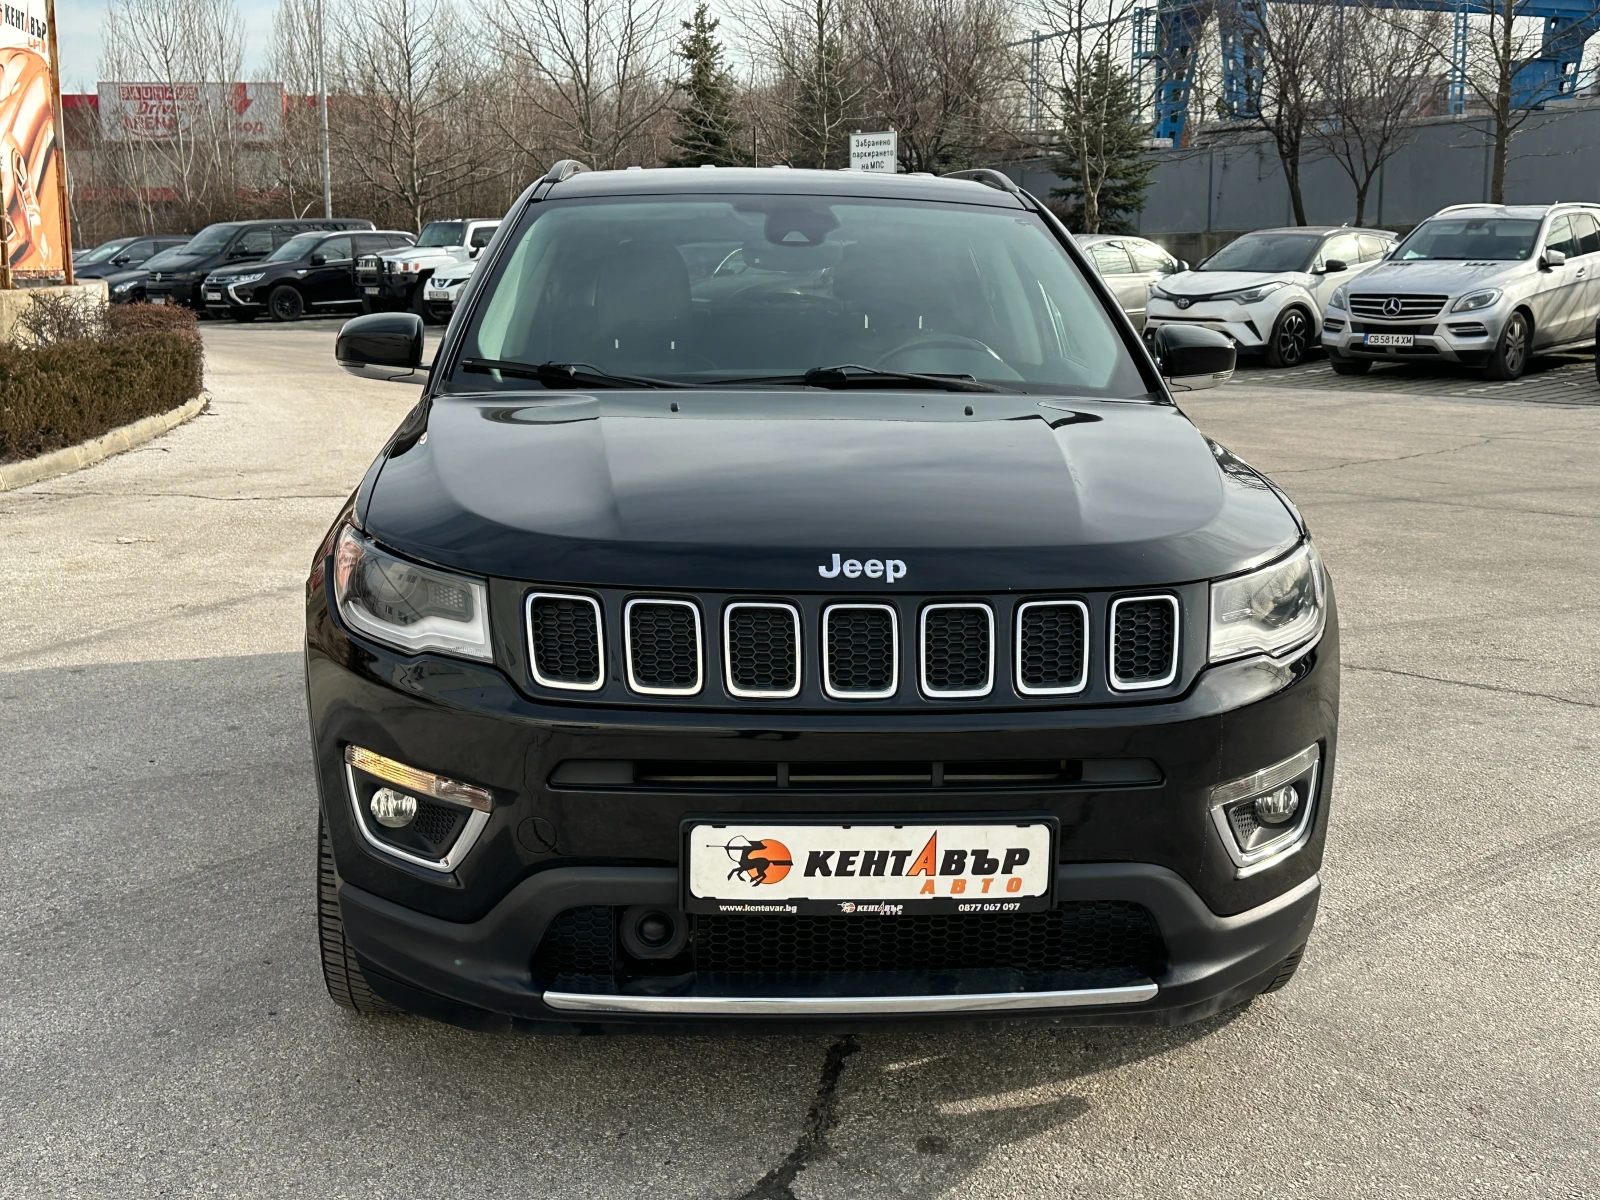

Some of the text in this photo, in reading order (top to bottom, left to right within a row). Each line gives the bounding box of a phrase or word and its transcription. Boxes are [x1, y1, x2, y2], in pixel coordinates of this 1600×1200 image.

[5, 1, 47, 40] КЕНТАВЪР
[855, 138, 891, 148] Забранено
[852, 150, 894, 159] паркирането
[870, 160, 885, 169] МПС
[818, 553, 907, 583] Jeep
[803, 830, 1030, 877] КЕНТАВЪР
[919, 877, 1023, 895] АВТО
[719, 904, 798, 914] www.kentavar.bg
[958, 903, 1021, 912] 0877 067 097
